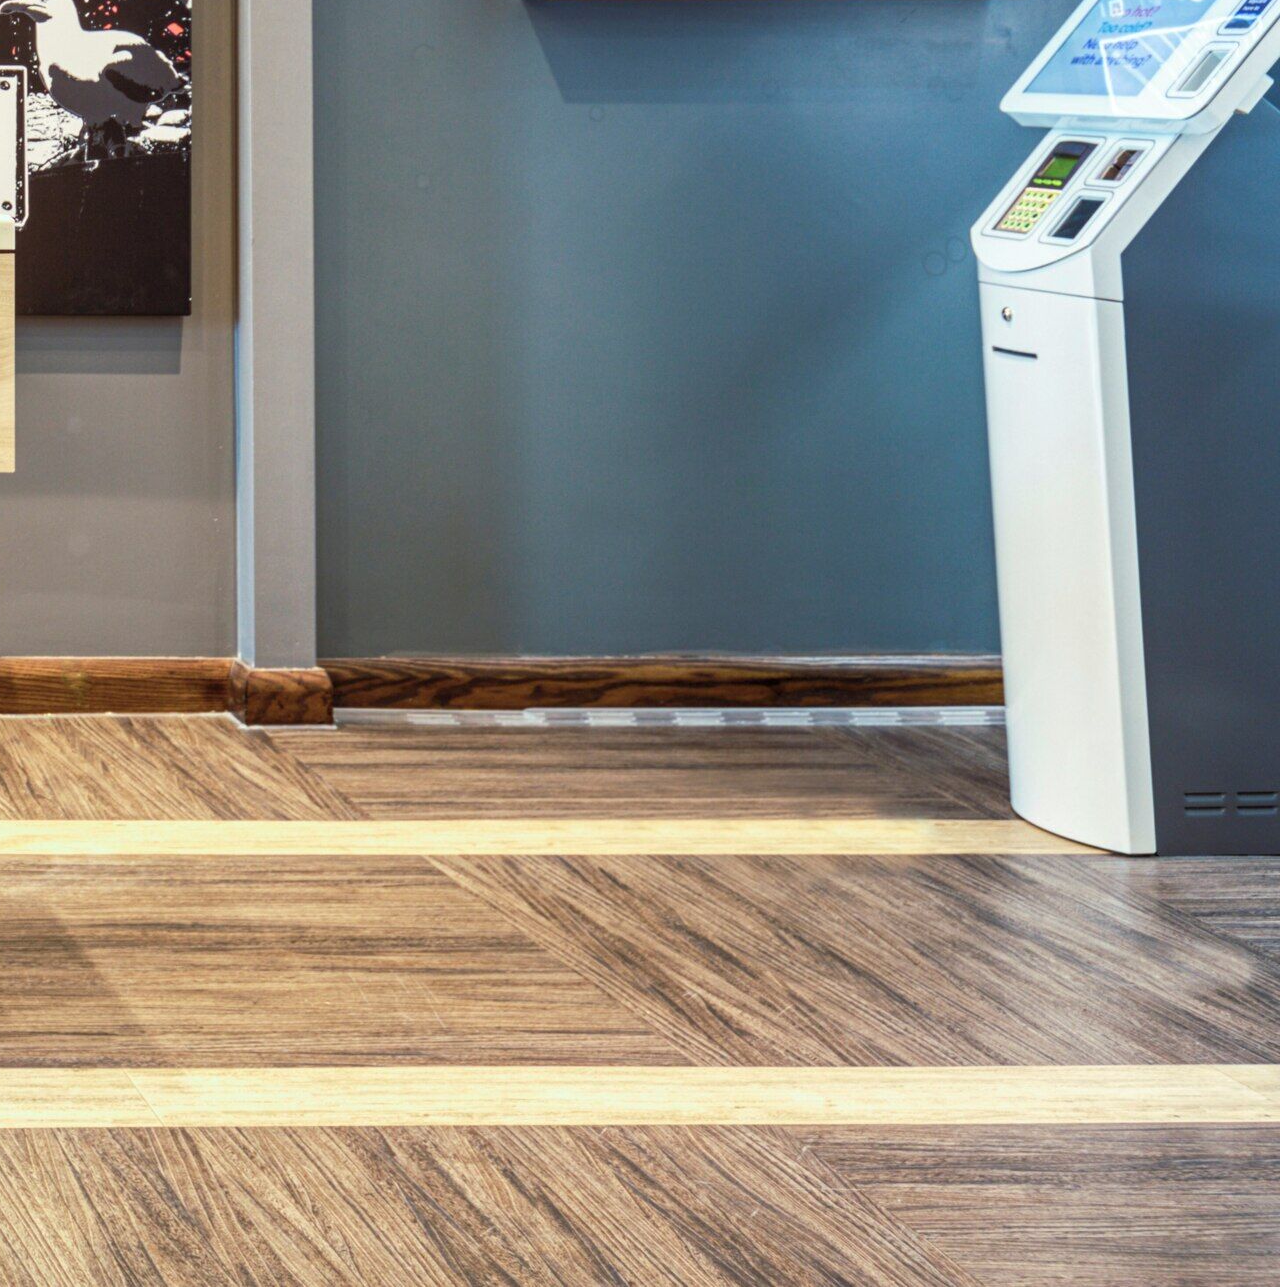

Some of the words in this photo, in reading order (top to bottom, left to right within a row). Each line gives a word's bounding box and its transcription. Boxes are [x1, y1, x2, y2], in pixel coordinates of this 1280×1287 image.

[1098, 21, 1118, 33] Too
[1119, 21, 1153, 33] cold?
[1070, 53, 1095, 65] with
